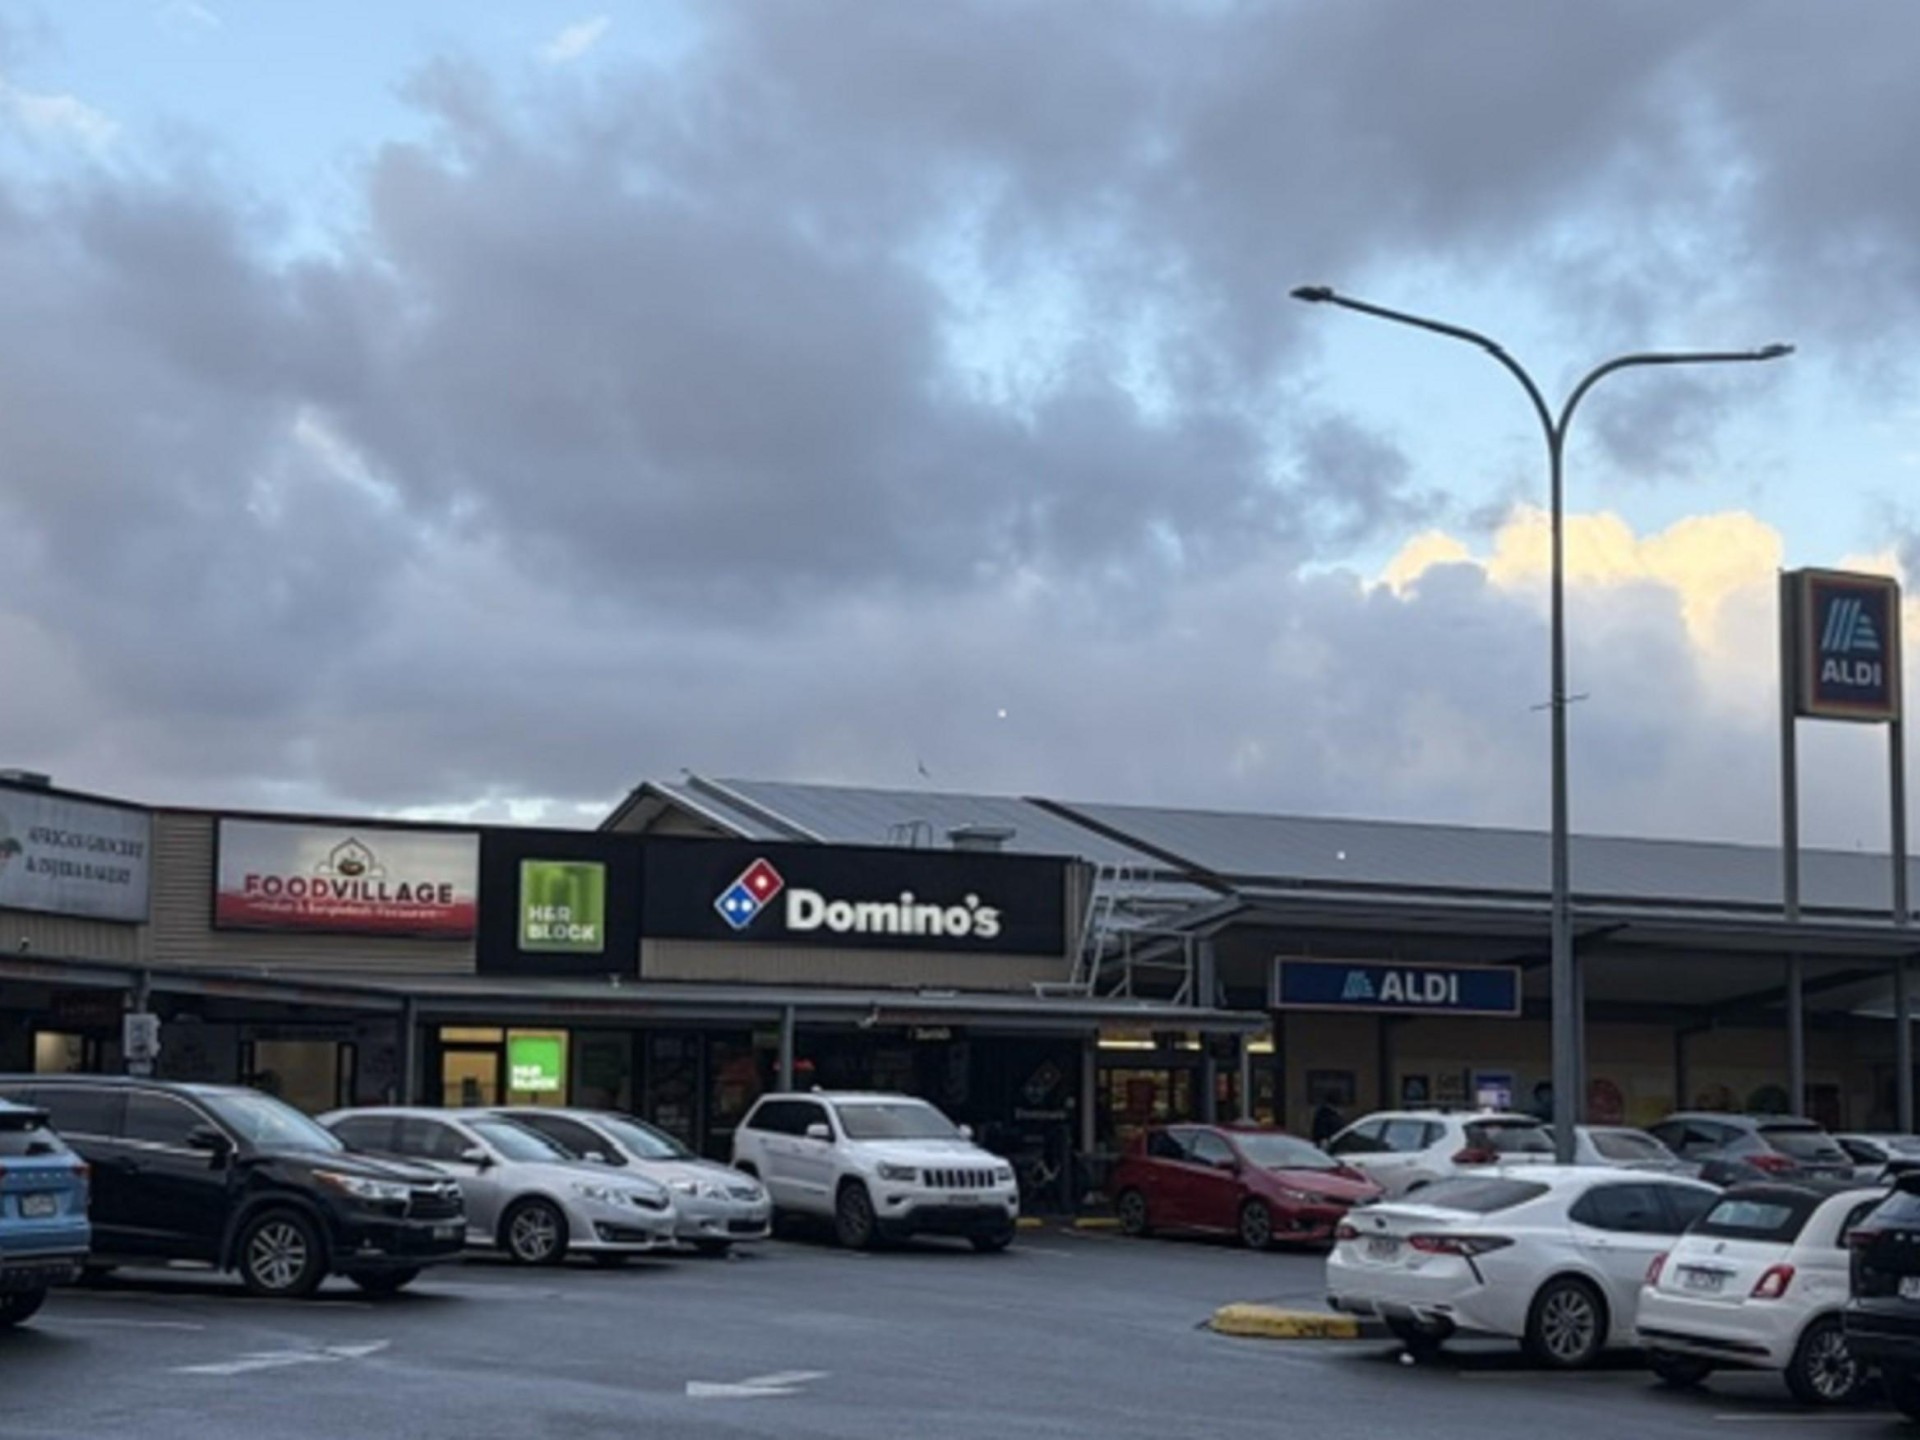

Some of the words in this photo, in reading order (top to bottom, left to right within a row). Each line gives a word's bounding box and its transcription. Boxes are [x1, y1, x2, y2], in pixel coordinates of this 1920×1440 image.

[1821, 659, 1882, 686] ALDI
[528, 906, 570, 921] H&R
[786, 889, 1000, 938] Domino's
[528, 924, 595, 942] BLOCK
[1379, 970, 1459, 1003] ALDI
